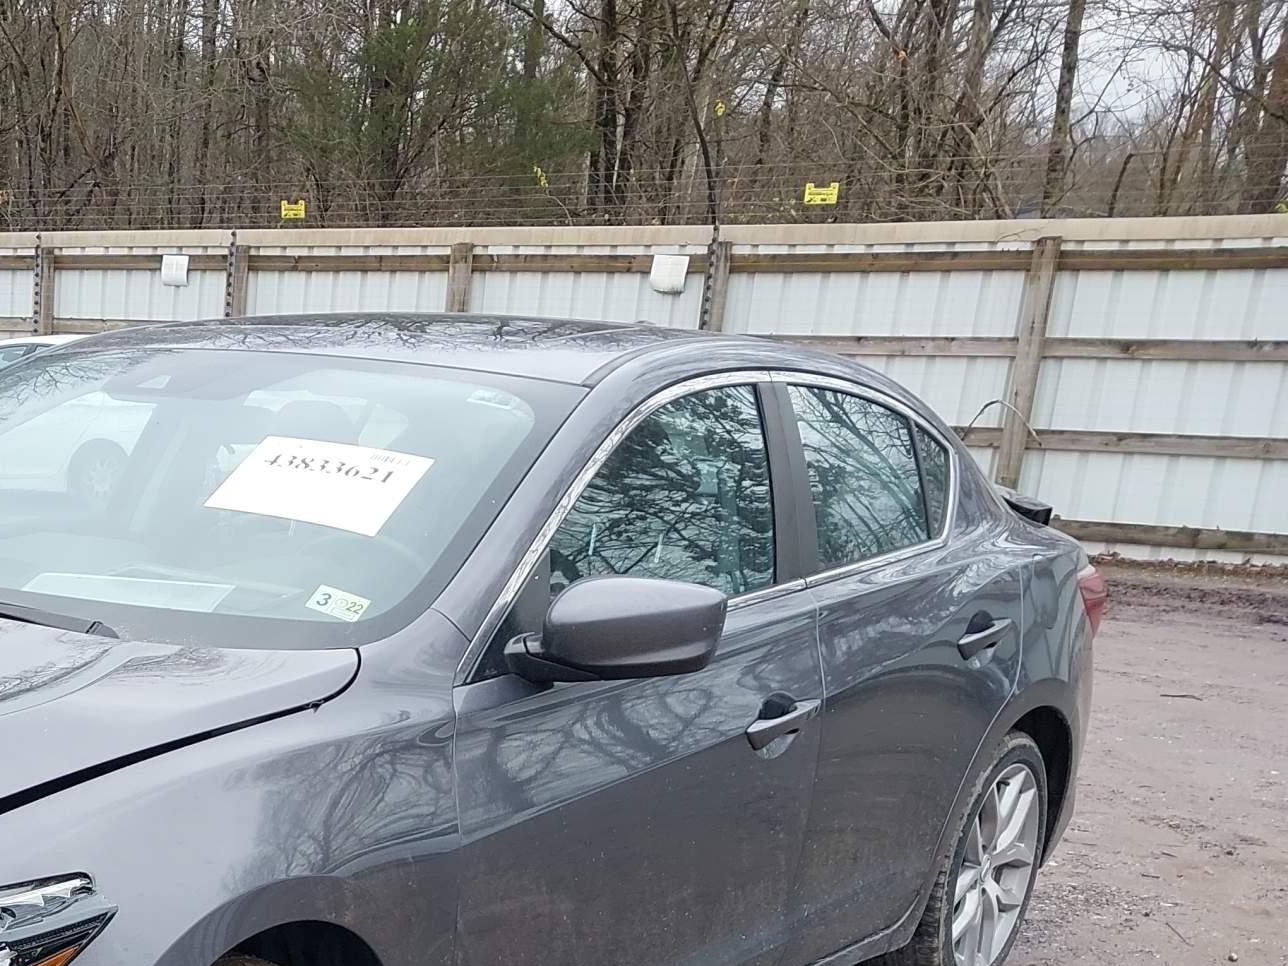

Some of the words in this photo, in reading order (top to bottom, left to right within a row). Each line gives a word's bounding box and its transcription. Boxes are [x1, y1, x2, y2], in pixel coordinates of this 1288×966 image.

[264, 452, 395, 484] 43833621
[316, 592, 332, 607] 3
[345, 601, 365, 615] 22
